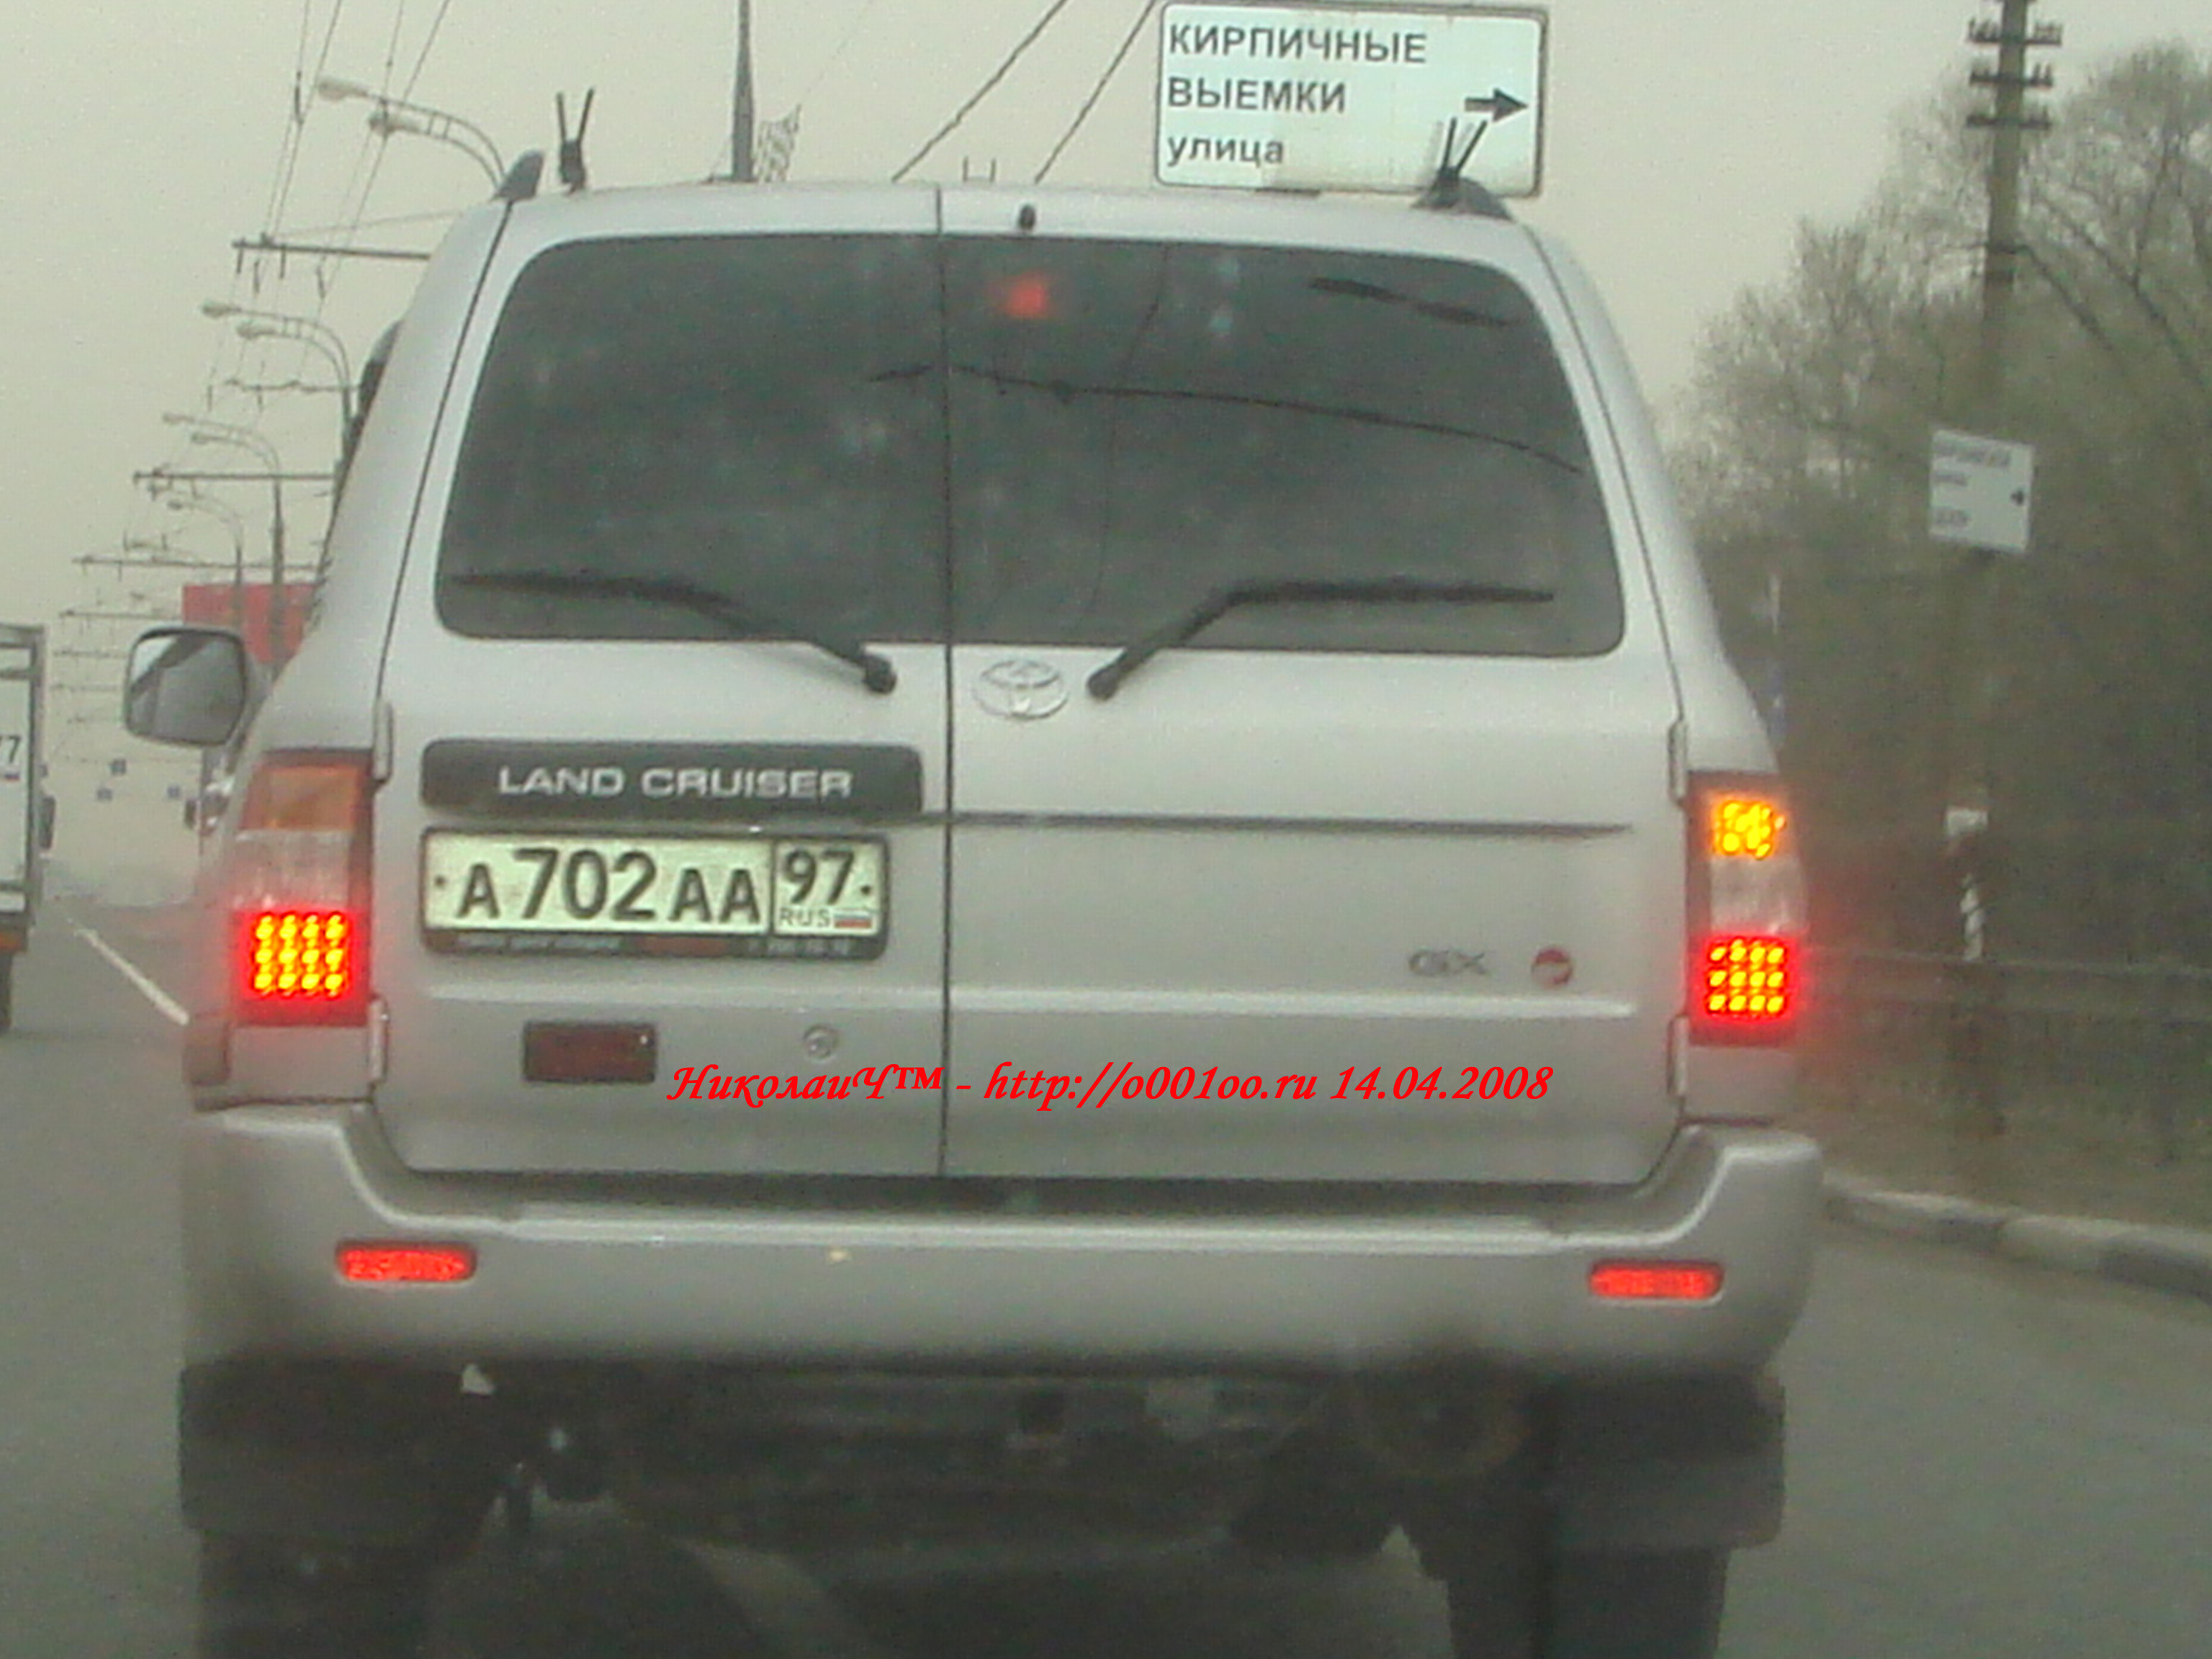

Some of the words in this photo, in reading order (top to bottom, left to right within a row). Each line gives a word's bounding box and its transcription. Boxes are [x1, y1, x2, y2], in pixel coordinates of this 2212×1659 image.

[1169, 24, 1427, 63] КИРПИЧНЫЕ
[1167, 76, 1346, 112] ВЫЕМКИ
[1167, 136, 1284, 168] улица
[499, 767, 625, 797] LAND
[642, 769, 853, 799] CRUISER
[781, 850, 855, 904] 97
[780, 907, 831, 928] RUS
